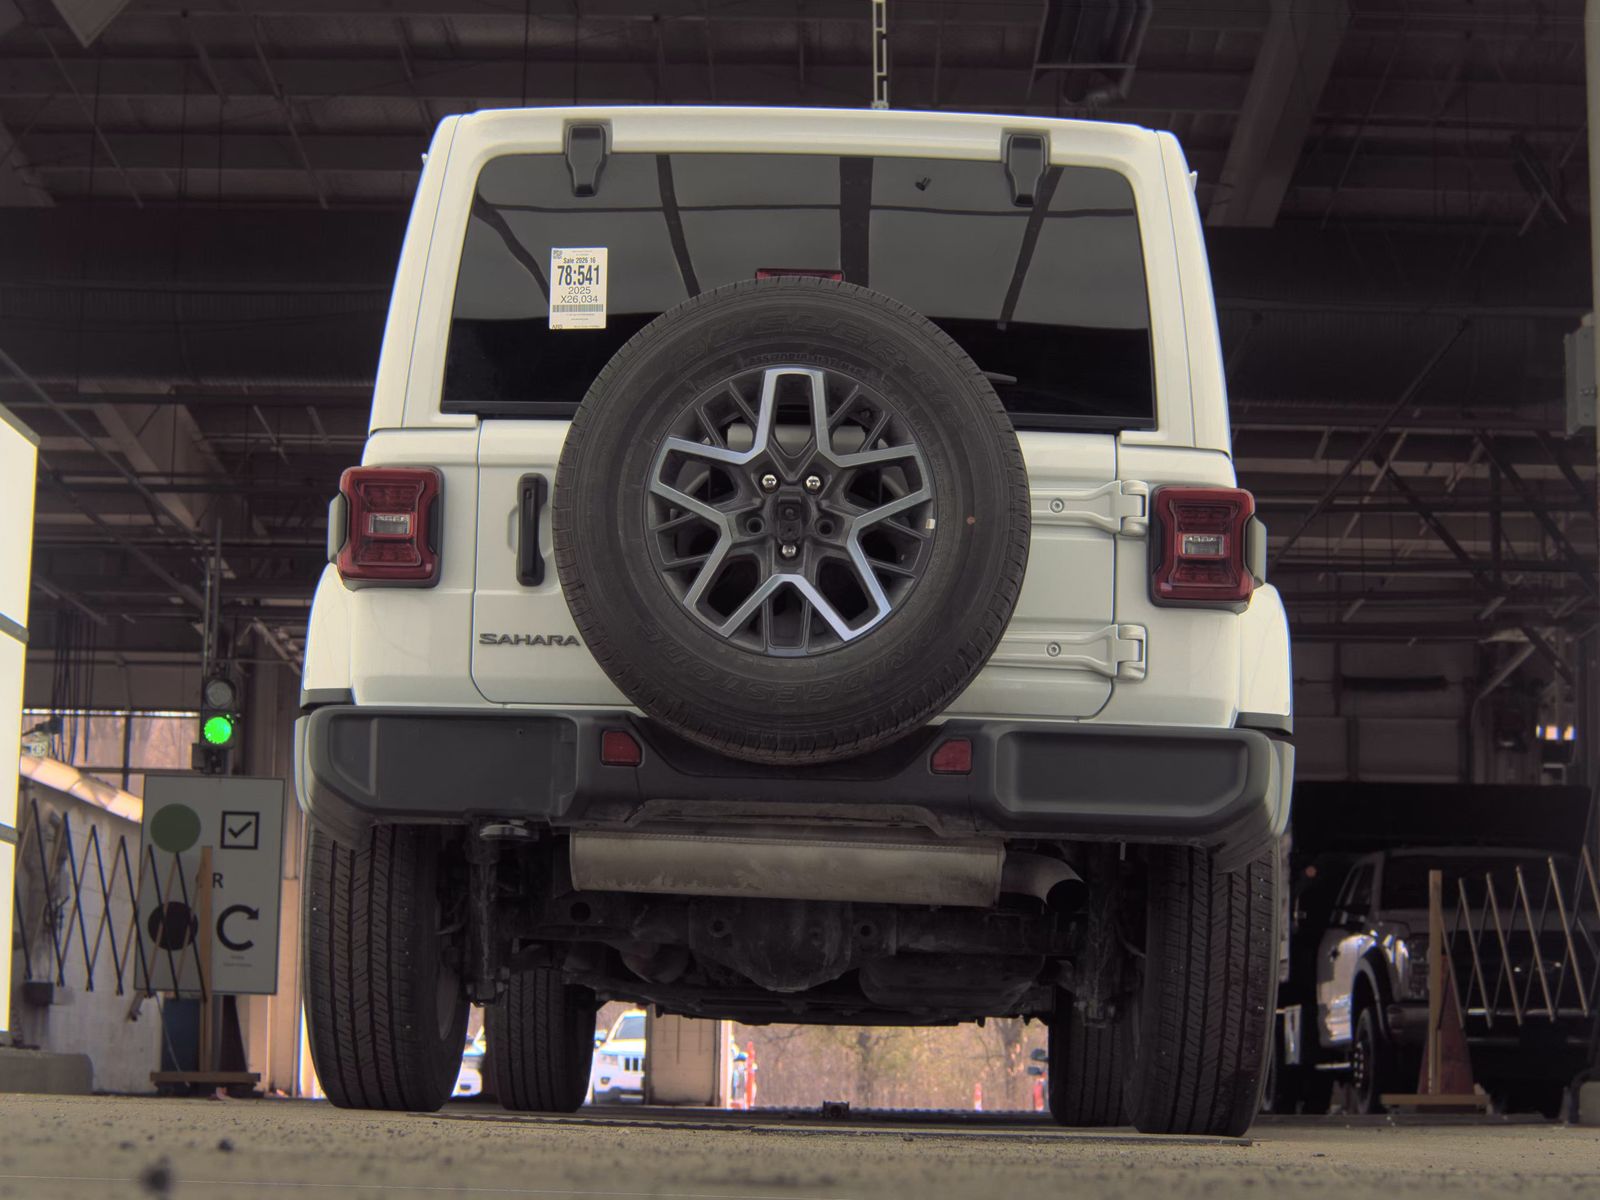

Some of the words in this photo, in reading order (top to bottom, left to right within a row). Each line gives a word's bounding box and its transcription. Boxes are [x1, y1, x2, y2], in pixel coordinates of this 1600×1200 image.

[557, 265, 600, 286] 78:541
[568, 286, 591, 295] 2025
[479, 633, 581, 646] SAHARA
